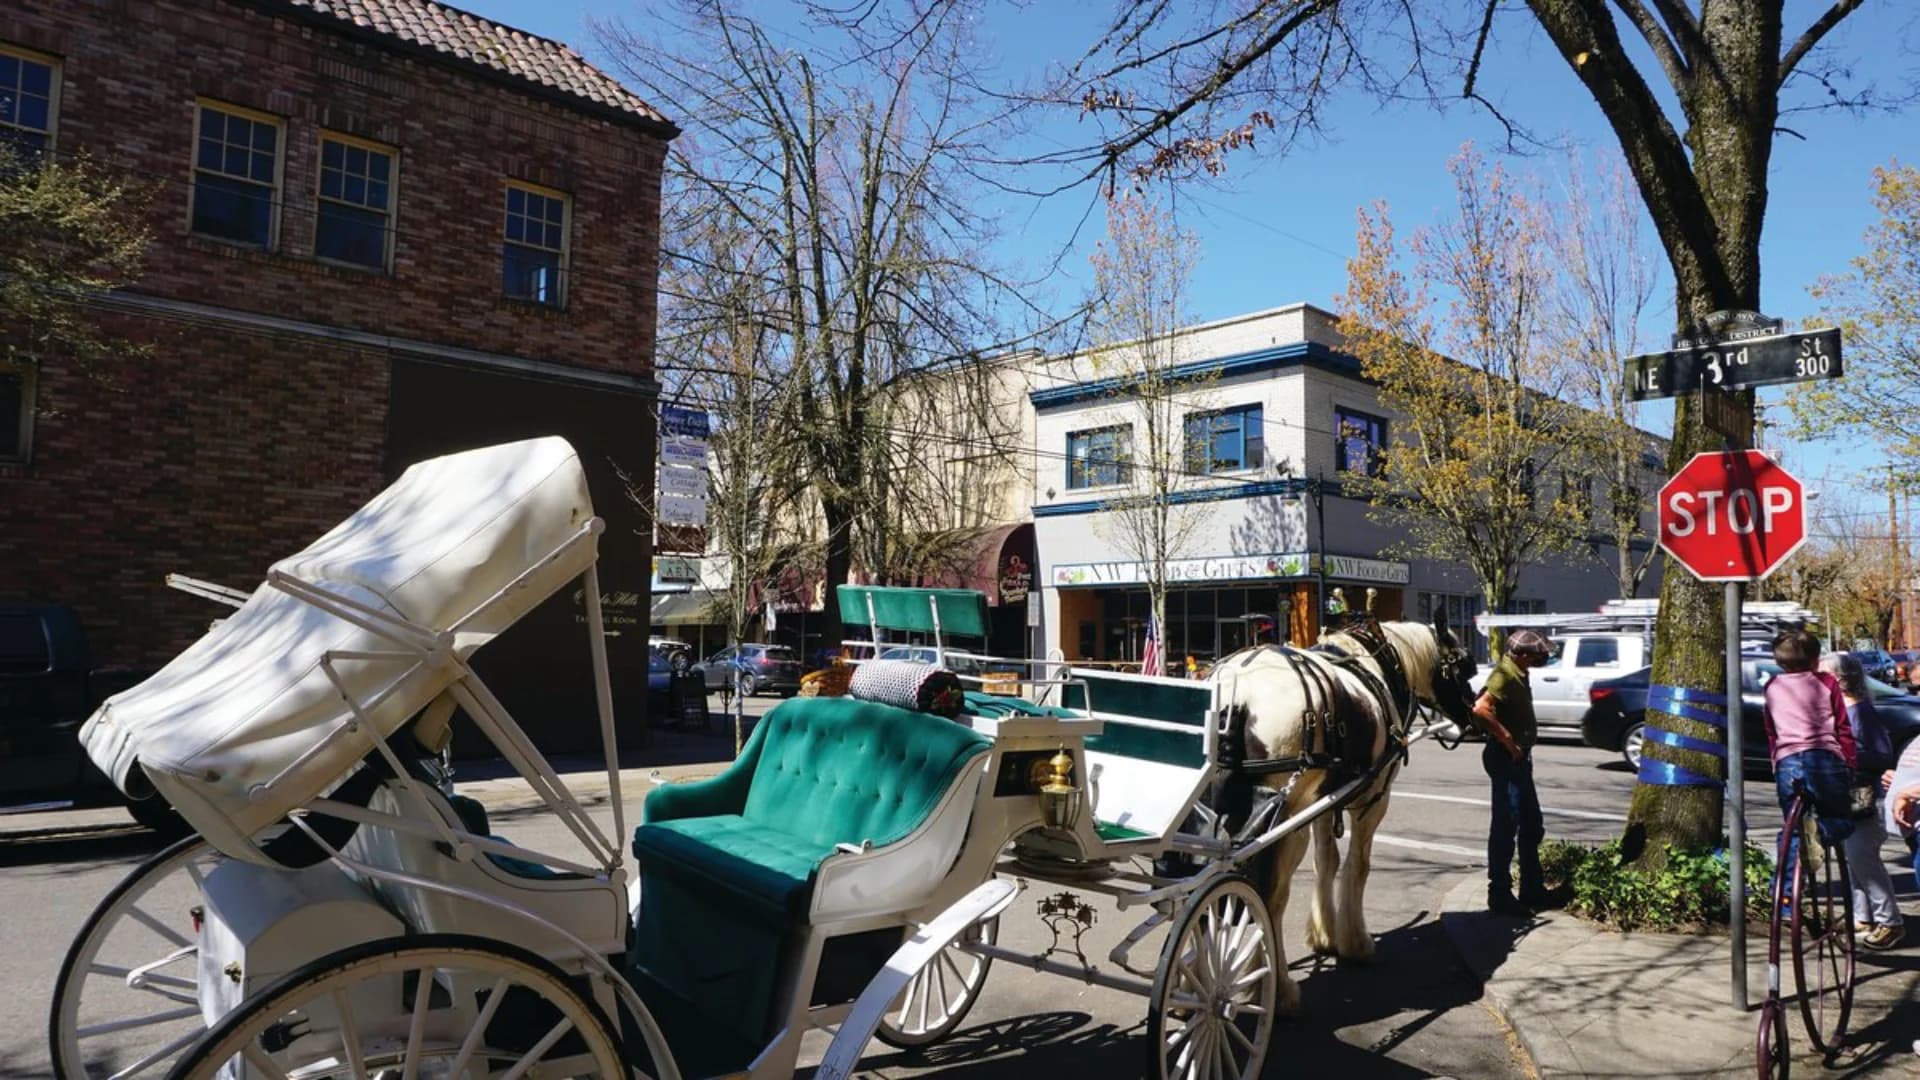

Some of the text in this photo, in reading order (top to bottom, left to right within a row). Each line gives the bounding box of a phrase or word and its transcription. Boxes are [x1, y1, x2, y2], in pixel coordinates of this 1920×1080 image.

[1729, 326, 1777, 341] DISTRICT
[1634, 337, 1822, 392] NE 3rd St
[1795, 355, 1830, 377] 300
[1668, 486, 1793, 537] STOP
[1336, 558, 1356, 576] NW
